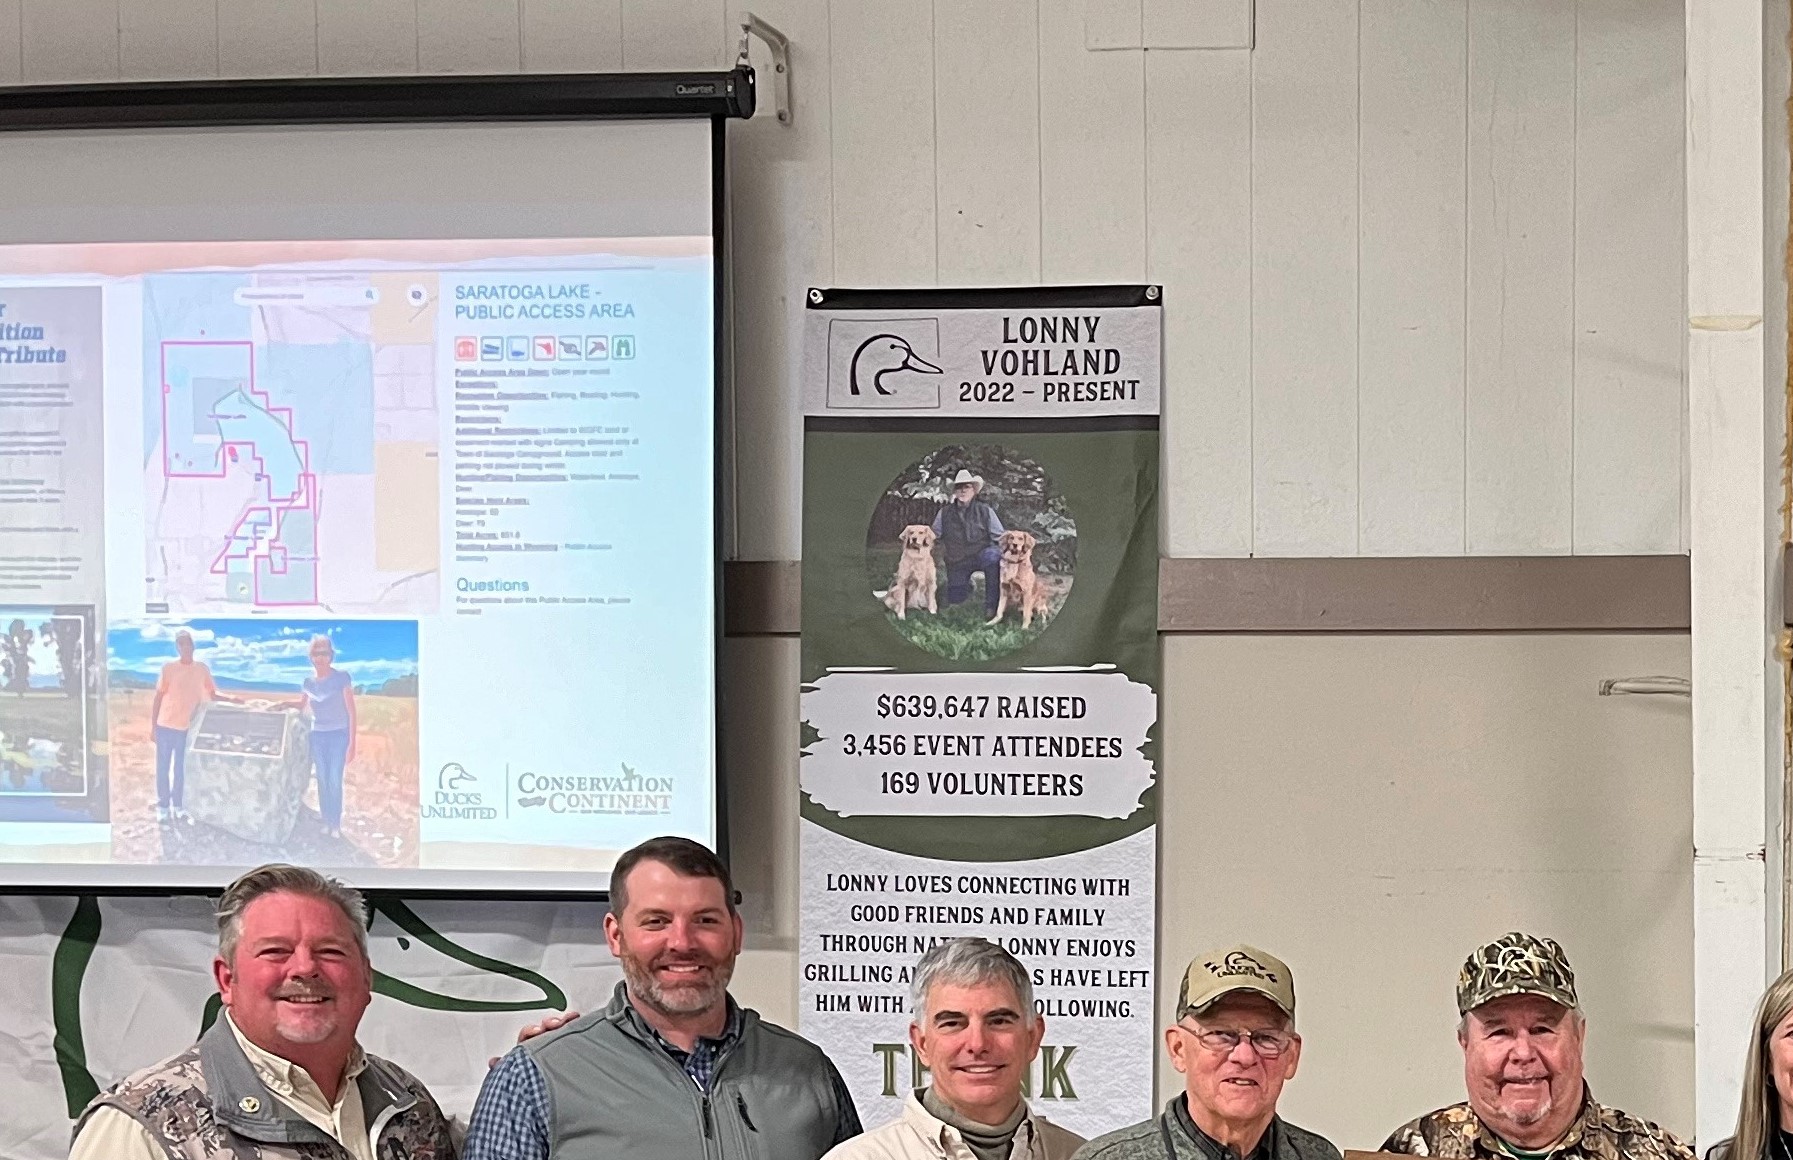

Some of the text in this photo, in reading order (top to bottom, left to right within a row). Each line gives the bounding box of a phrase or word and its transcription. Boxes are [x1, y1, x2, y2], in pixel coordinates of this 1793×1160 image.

[456, 285, 545, 300] SARATOGA
[549, 284, 589, 299] LAKE
[455, 303, 635, 319] PUBLIC ACCESS AREA
[1002, 316, 1101, 344] LONNY
[981, 349, 1121, 376] VOHLAND
[959, 382, 1014, 402] 2022
[1043, 379, 1140, 402] PRESENT
[456, 577, 530, 593] Questions
[877, 694, 1087, 720] $639,647 RAISED
[843, 734, 1123, 759] 3,456 EVENT ATTENDEES
[518, 772, 674, 794] CONSERVATION
[881, 772, 1083, 797] 169 VOLUNTEERS
[435, 791, 482, 805] DUCKS
[549, 793, 672, 813] CONTINENT
[420, 805, 497, 820] UNLIMITED
[827, 874, 1130, 897] LONNY LOVES CONNECTING WITH
[850, 905, 1106, 927] GOOD FRIENDS AND FAMILY
[820, 934, 908, 954] THROUGH
[1067, 939, 1136, 958] ENJOYS
[804, 964, 893, 984] GRILLING
[1050, 968, 1101, 988] HAVE
[1106, 969, 1150, 988] LEFT
[815, 995, 851, 1013] HIM
[857, 995, 904, 1014] WITH
[1034, 998, 1136, 1018] OLLOWING.
